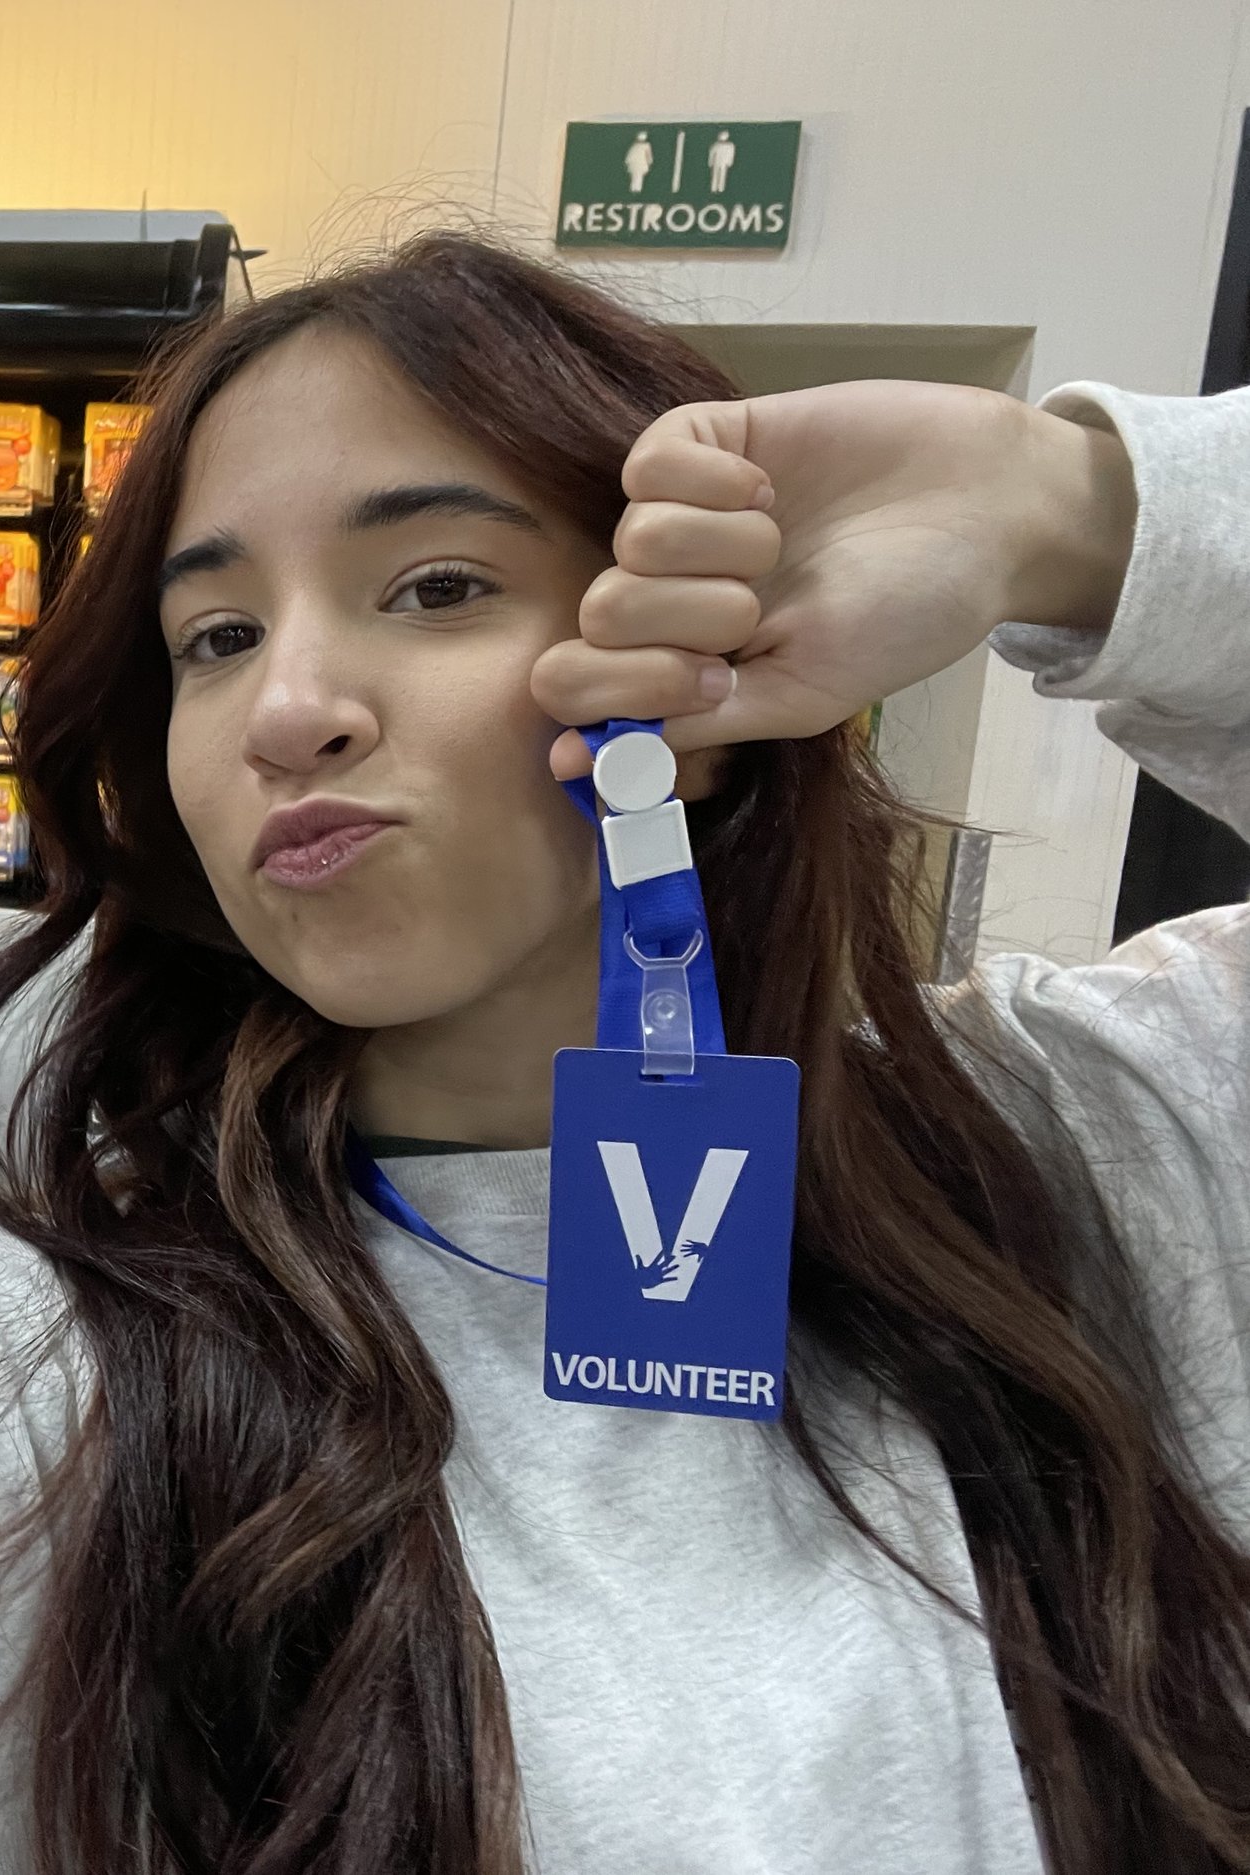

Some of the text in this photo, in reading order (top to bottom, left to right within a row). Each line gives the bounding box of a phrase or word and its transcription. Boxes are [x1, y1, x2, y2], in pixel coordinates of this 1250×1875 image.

[563, 203, 784, 233] RESTROOMS
[596, 1140, 750, 1302] V
[551, 1352, 775, 1406] VOLUNTEER
